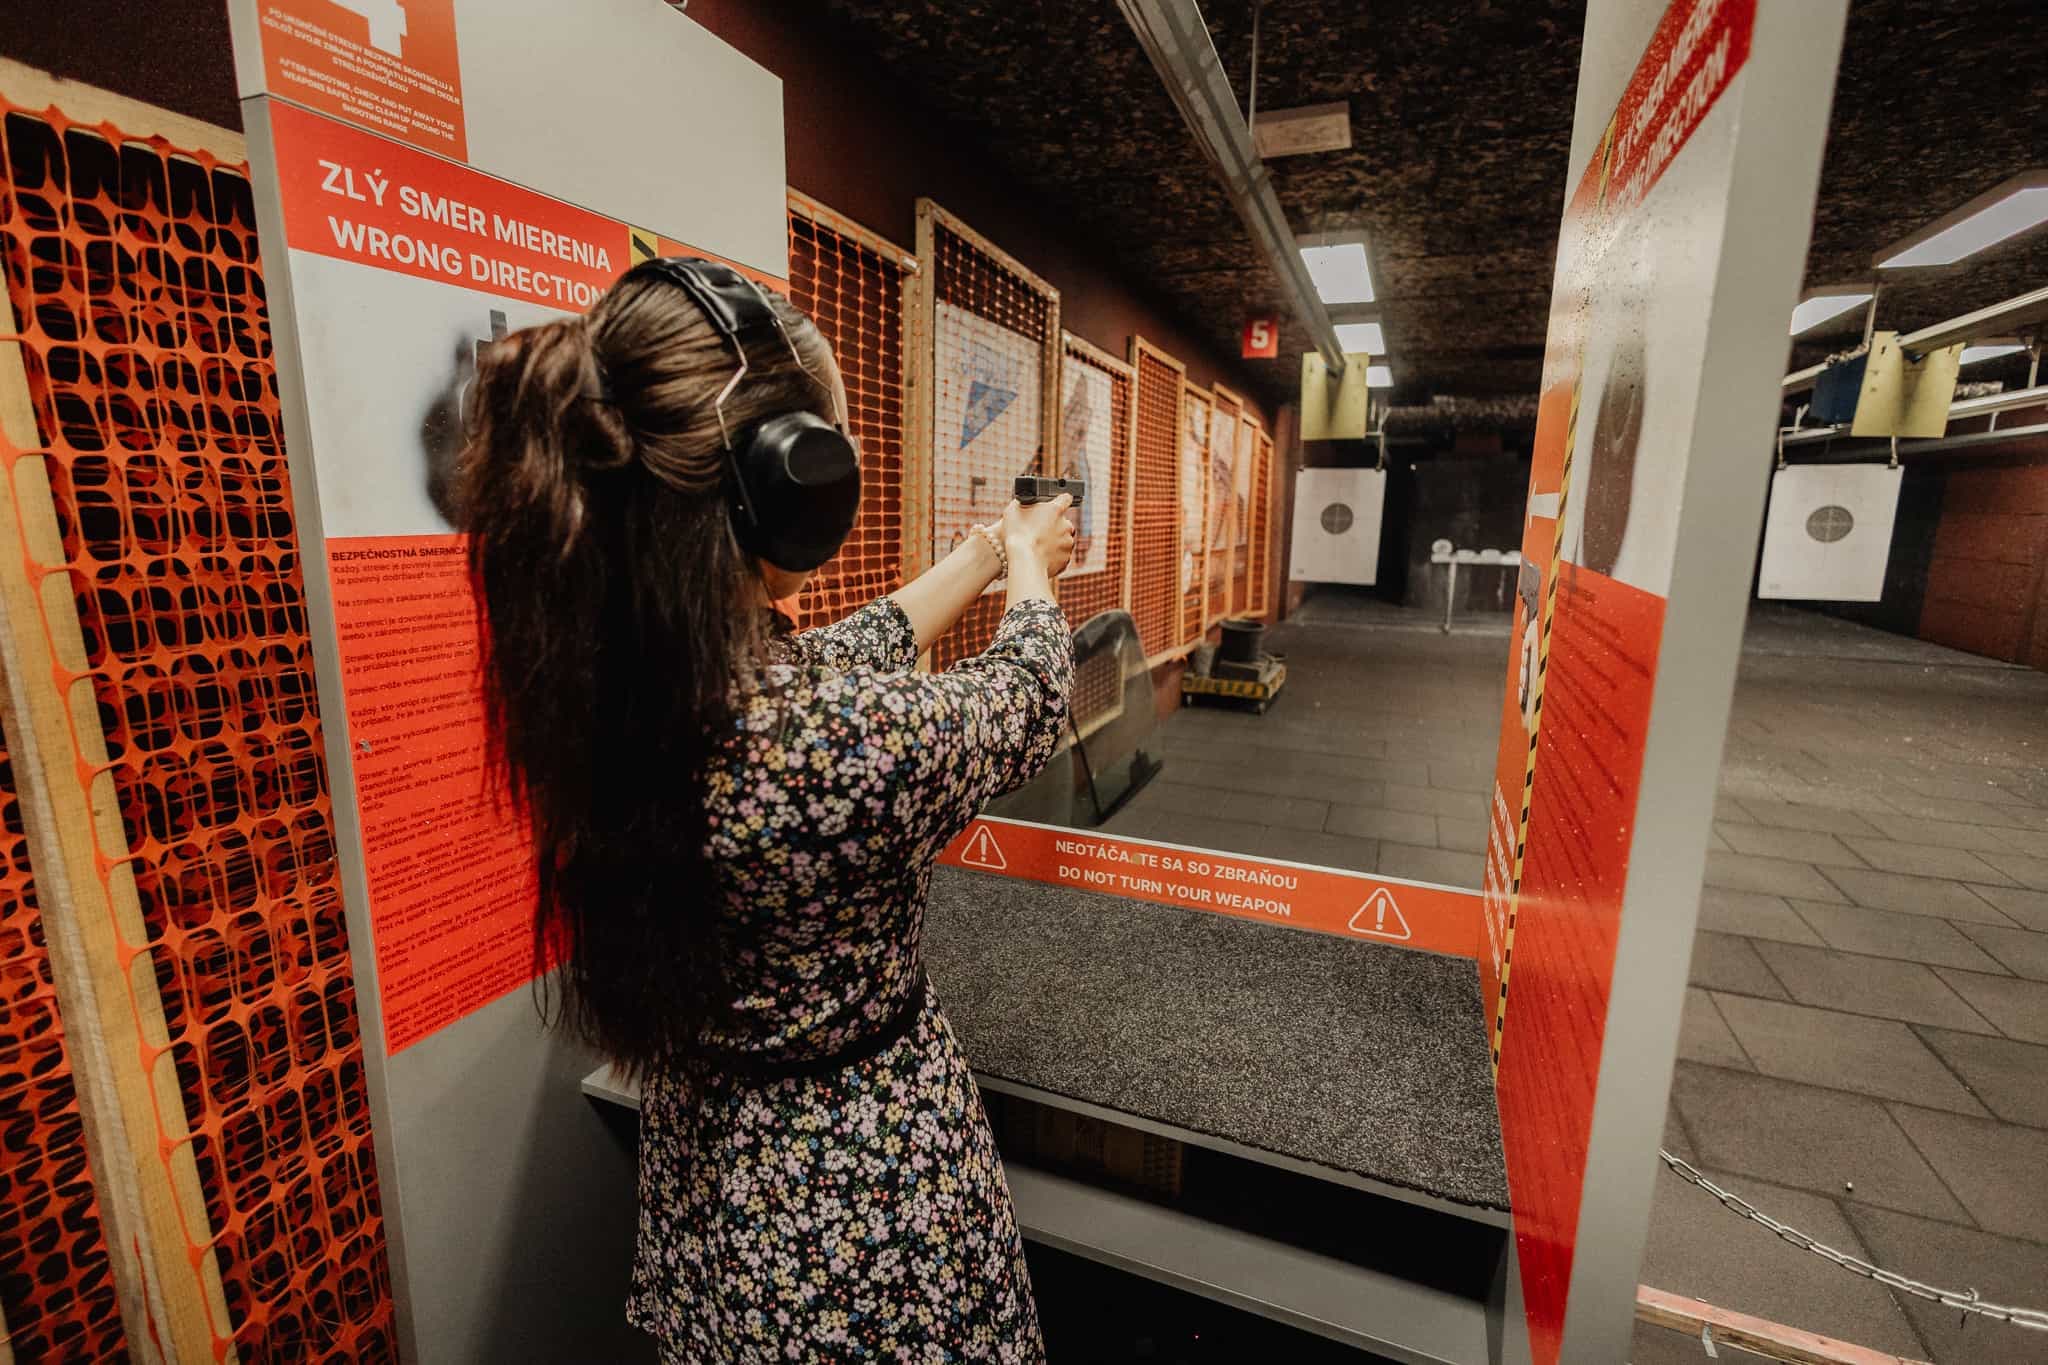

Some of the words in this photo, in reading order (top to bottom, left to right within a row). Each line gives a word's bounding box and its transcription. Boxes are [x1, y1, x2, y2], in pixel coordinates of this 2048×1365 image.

[279, 57, 306, 73] AFTER
[353, 86, 381, 103] CHECK
[381, 97, 398, 109] AND
[398, 103, 412, 114] PUT
[413, 110, 435, 124] AWAY
[357, 99, 374, 110] AND
[375, 105, 400, 120] CLEAN
[318, 159, 388, 207] ZLÝ
[400, 185, 487, 236] SMER
[493, 214, 612, 272] MIERENIA
[328, 215, 463, 275] WRONG
[1251, 320, 1269, 349] 5
[332, 547, 417, 561] BEZPEČNOSTNÁ
[1056, 840, 1158, 867] NEOTÁČATE
[1162, 857, 1183, 872] SA
[1188, 861, 1211, 876] SO
[1214, 864, 1298, 890] ZBRAŇOU
[1059, 865, 1081, 880] DO
[1084, 870, 1116, 886] NOT
[1120, 875, 1162, 895] TURN
[1166, 883, 1212, 903] YOUR
[1215, 891, 1291, 917] WEAPON
